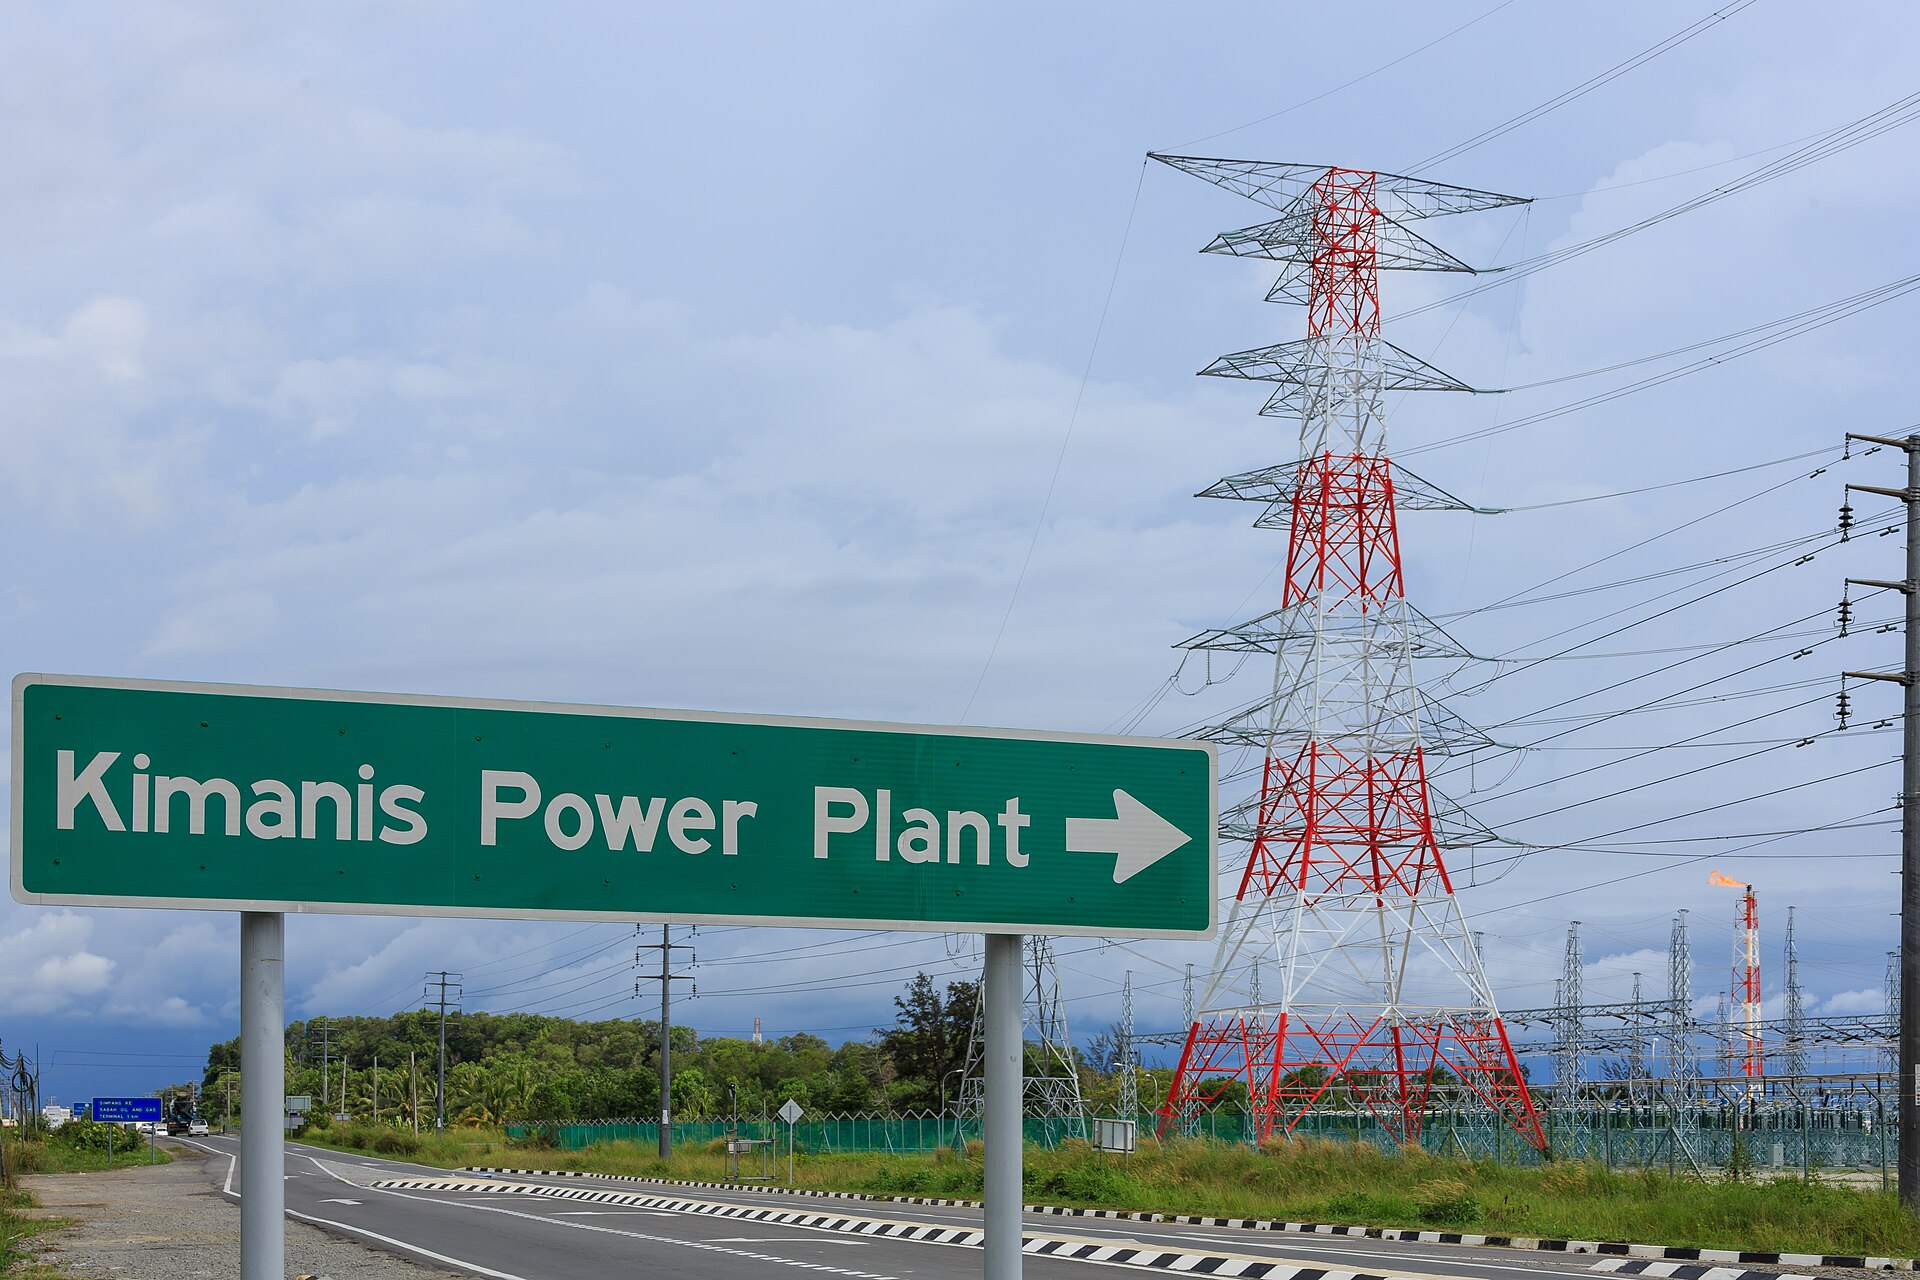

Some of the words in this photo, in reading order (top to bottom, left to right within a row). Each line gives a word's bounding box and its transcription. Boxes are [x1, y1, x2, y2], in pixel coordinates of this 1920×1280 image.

[56, 749, 428, 846] Kimanis
[480, 769, 758, 856] Power
[813, 785, 1031, 868] Plant
